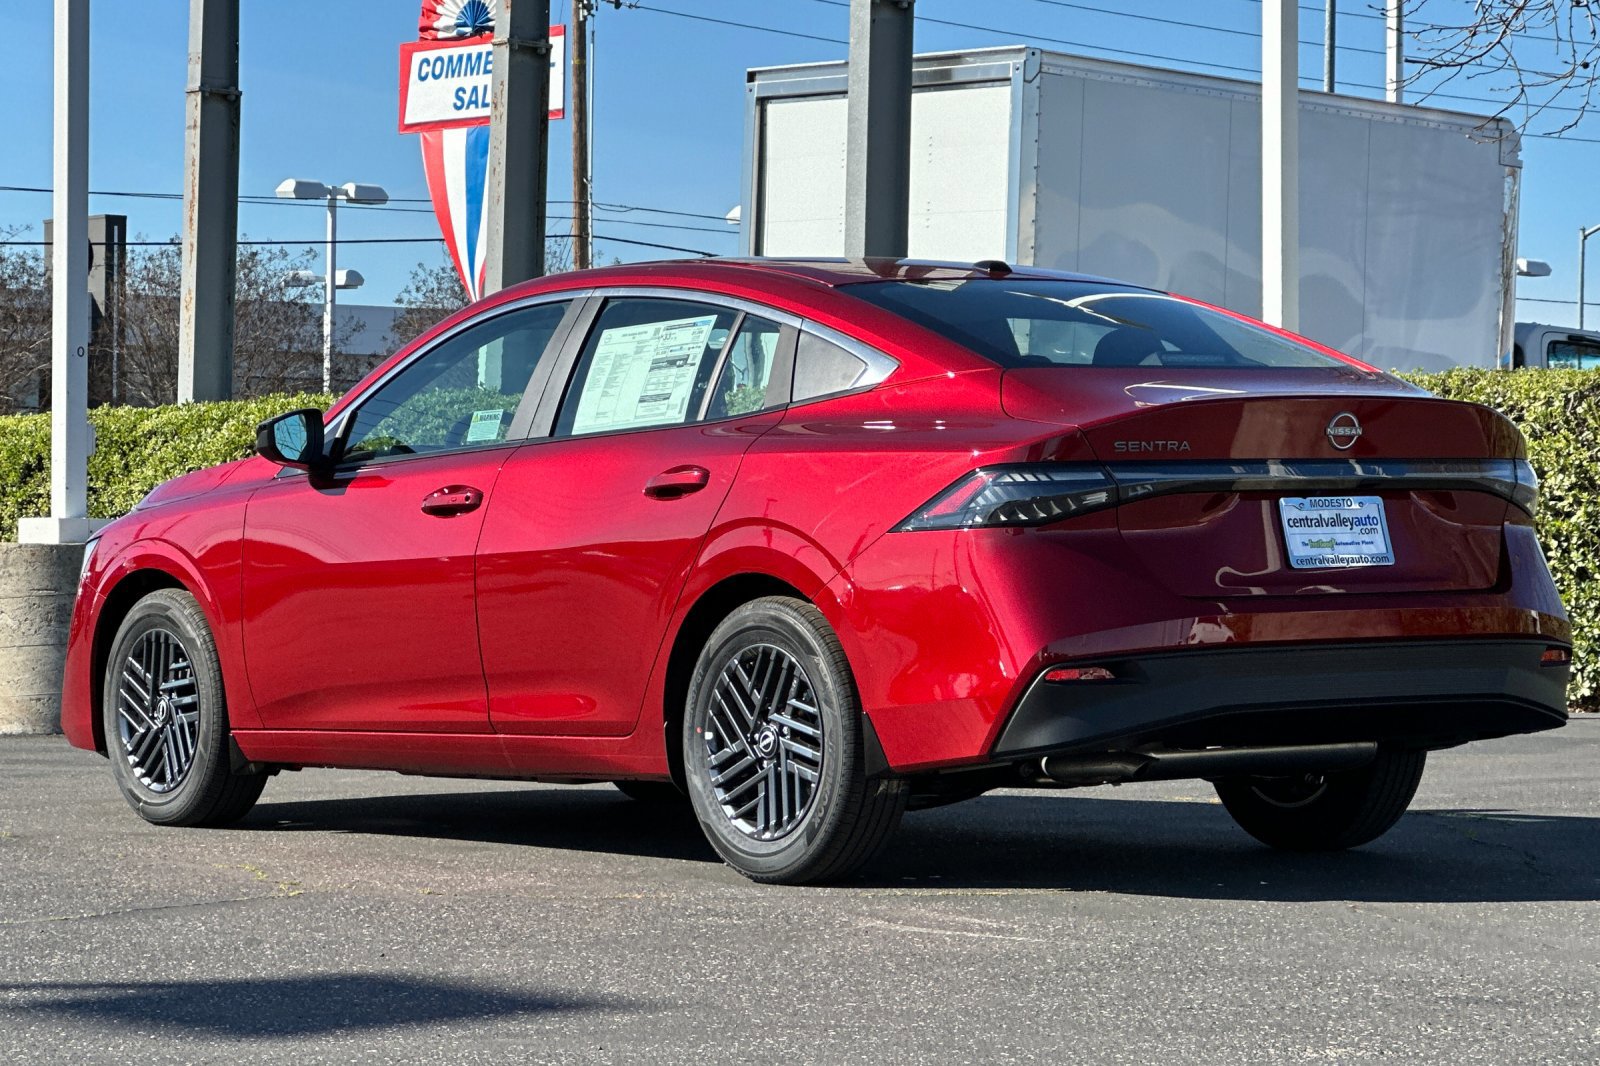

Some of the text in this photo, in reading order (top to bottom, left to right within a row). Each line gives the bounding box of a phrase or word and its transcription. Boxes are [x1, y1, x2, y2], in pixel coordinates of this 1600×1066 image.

[417, 50, 493, 82] COMME
[453, 84, 491, 111] SAL
[1326, 426, 1363, 436] NISSAN
[1113, 440, 1191, 452] SENTRA
[1309, 498, 1353, 509] MODESTO
[1287, 512, 1379, 531] centralvalleyauto
[1358, 527, 1379, 536] .com
[1296, 554, 1390, 568] centralvalleyauto.com
